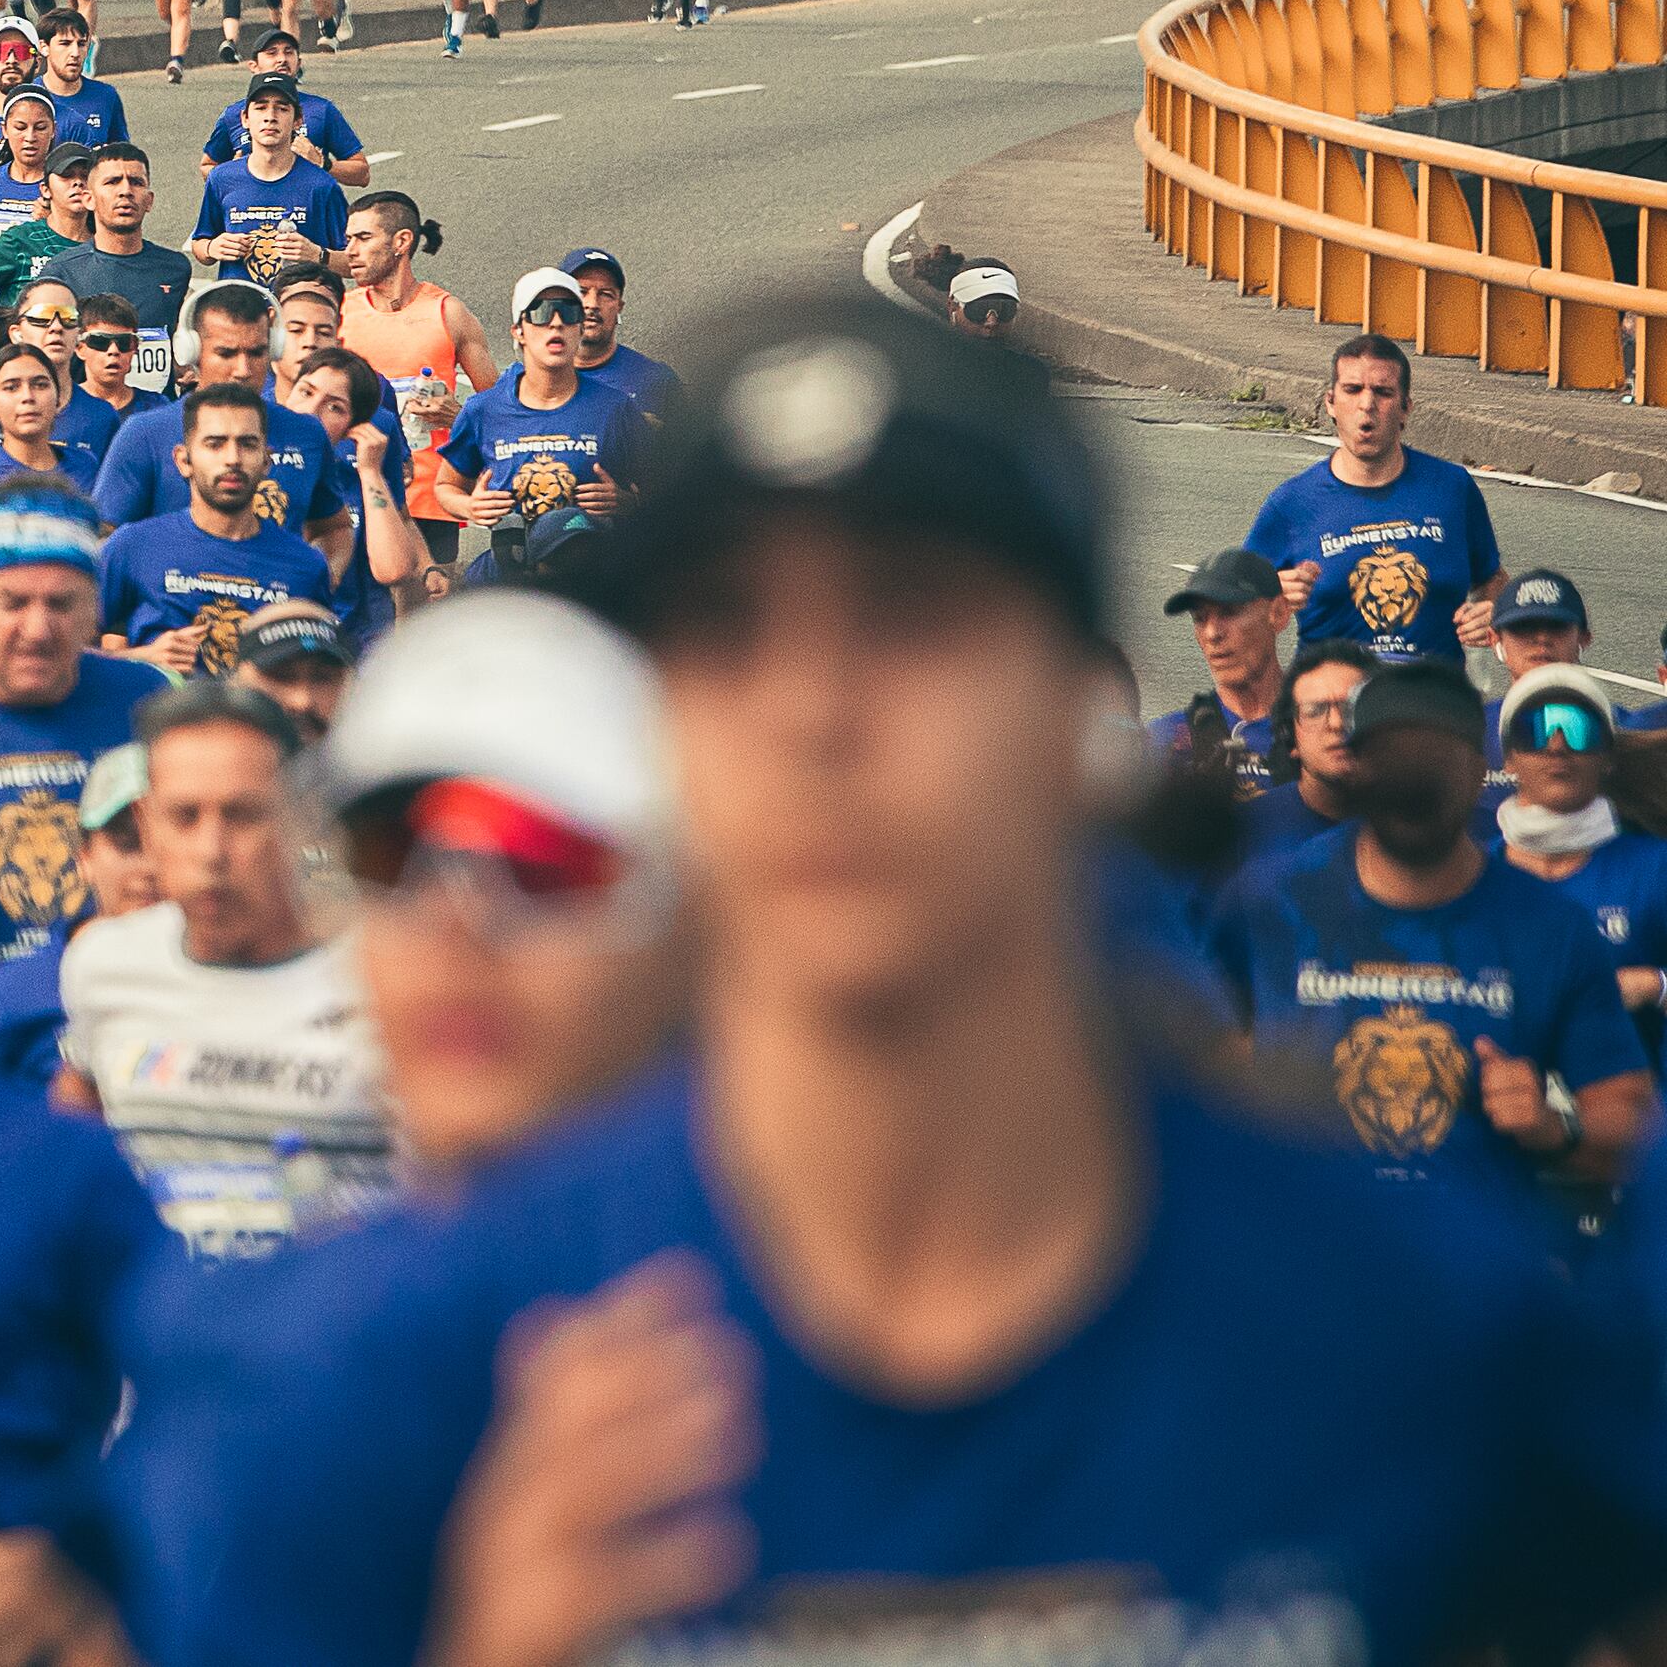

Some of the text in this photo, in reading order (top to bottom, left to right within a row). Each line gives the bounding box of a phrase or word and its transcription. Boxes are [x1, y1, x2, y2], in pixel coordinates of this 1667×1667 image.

[230, 210, 306, 223] RUNNERSAR
[495, 439, 598, 455] RUNNERSTAR
[1321, 524, 1444, 553] RUNNERSTAR
